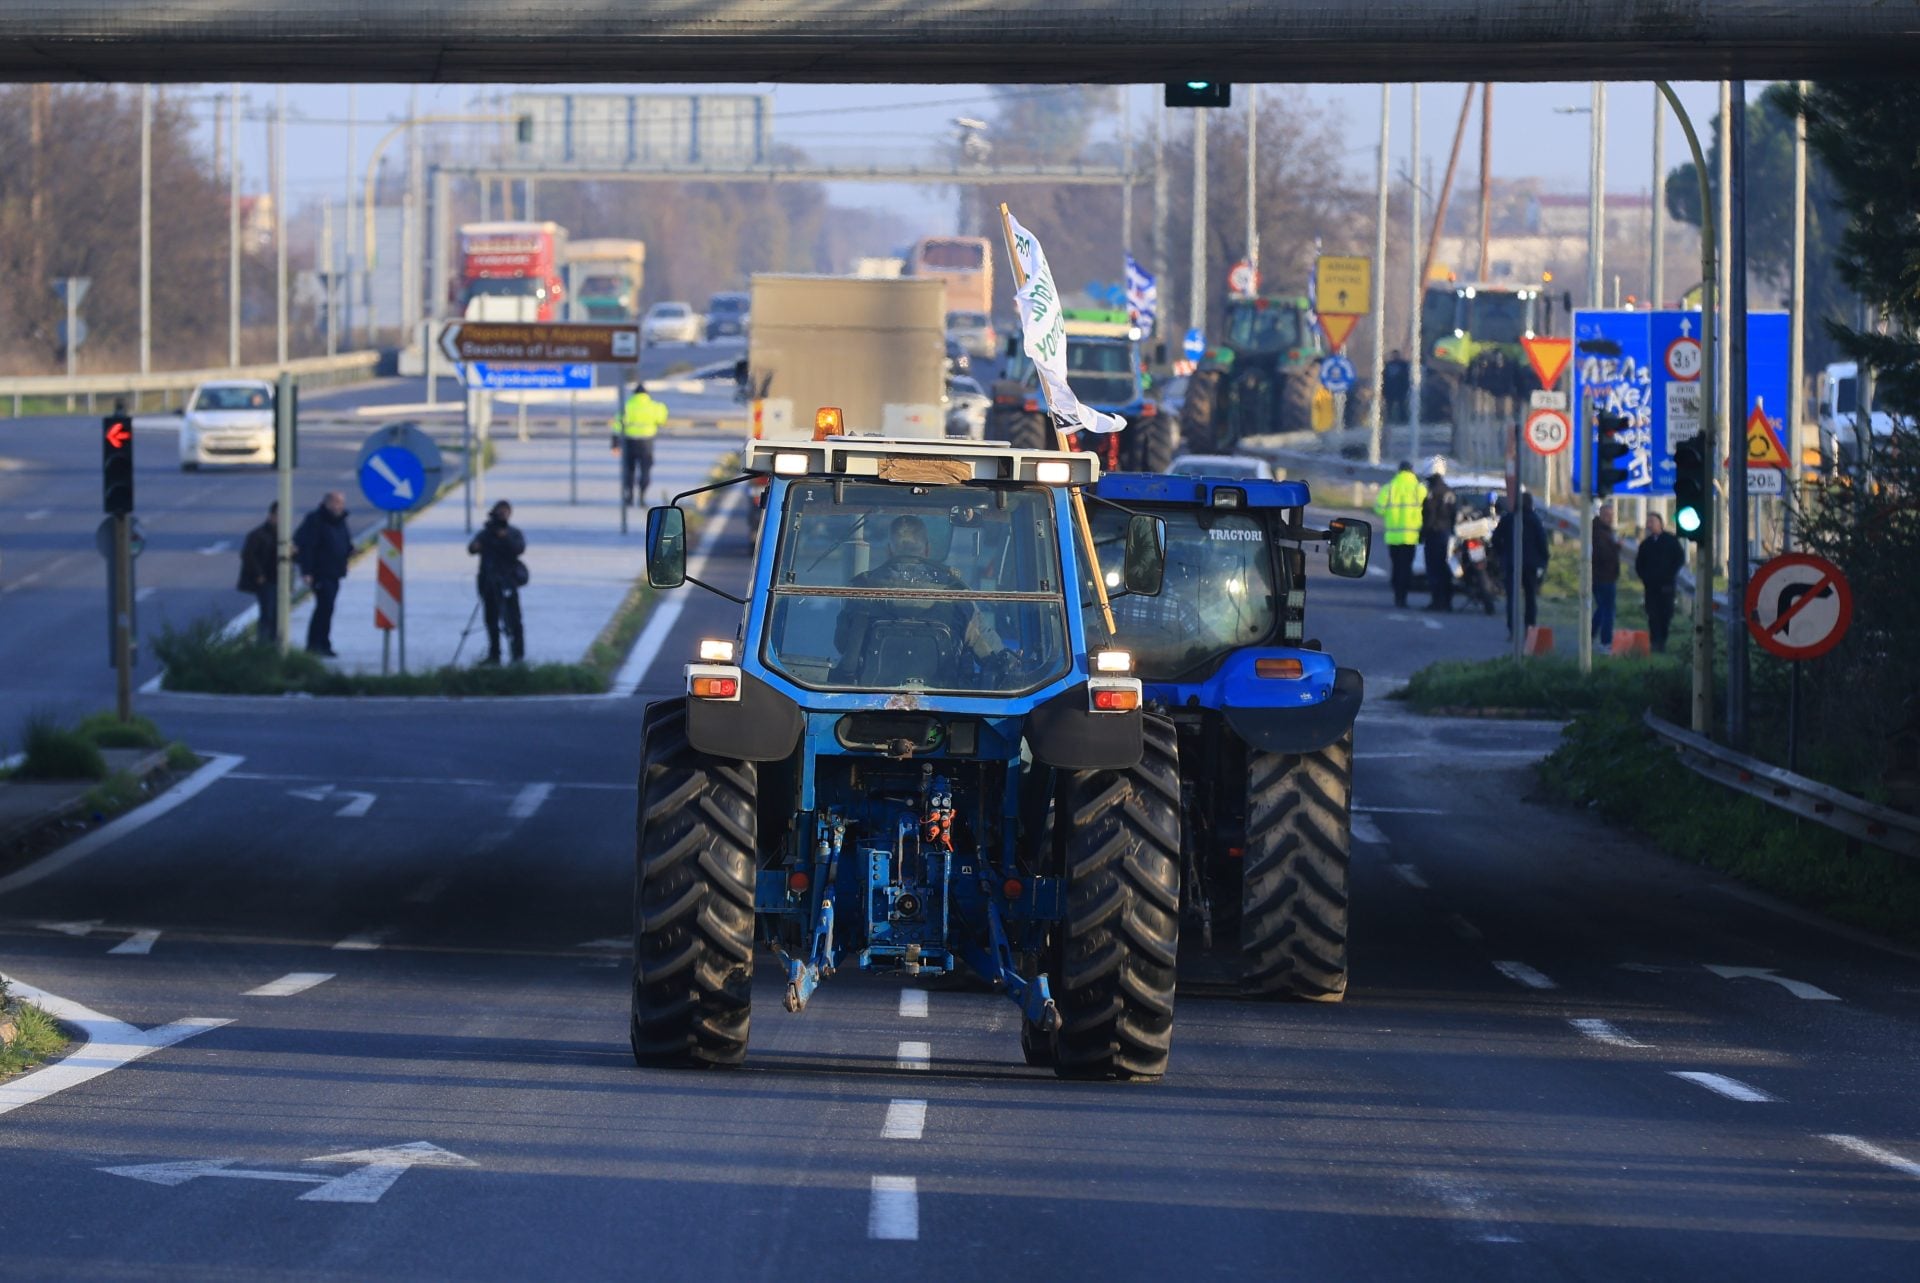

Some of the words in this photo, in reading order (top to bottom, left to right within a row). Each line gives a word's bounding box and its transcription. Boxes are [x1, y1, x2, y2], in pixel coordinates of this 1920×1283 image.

[463, 342, 524, 356] Beaches
[527, 343, 542, 356] of
[1535, 422, 1561, 442] 50
